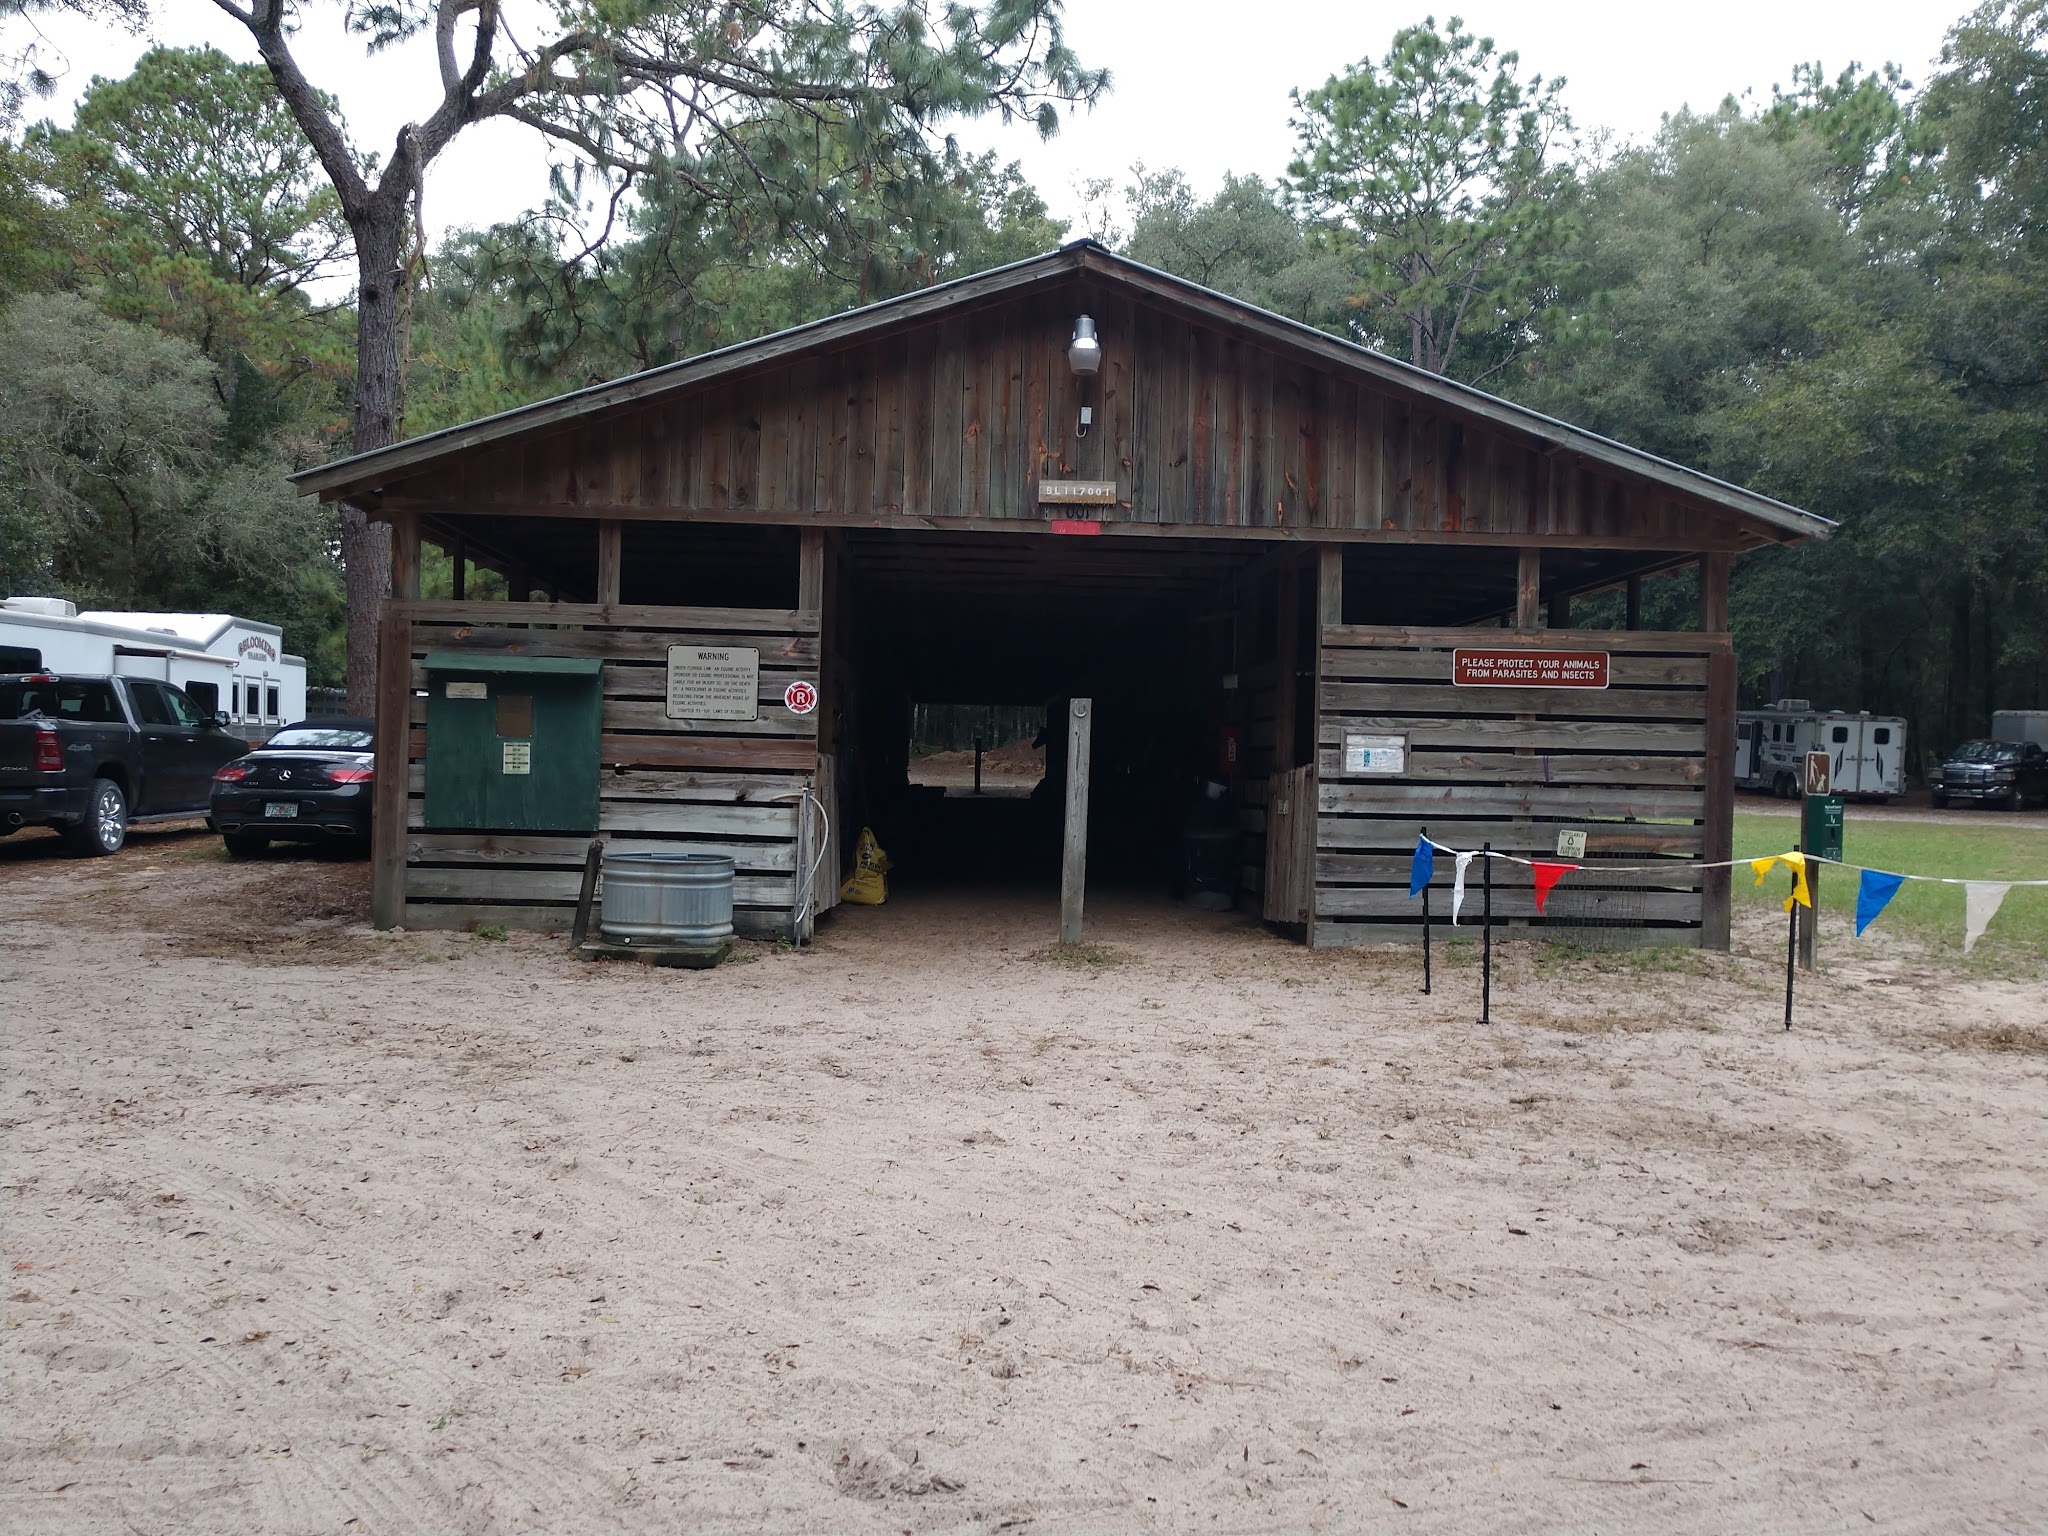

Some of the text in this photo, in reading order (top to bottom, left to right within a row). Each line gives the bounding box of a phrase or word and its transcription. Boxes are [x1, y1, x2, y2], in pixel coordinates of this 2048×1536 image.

[1046, 486, 1110, 496] BL117001
[698, 652, 729, 660] WARNING
[1462, 658, 1600, 669] PLEASE PROTECT YOUR ANIMALS
[1466, 669, 1594, 680] FROM PARASITES AND INSECTS
[796, 692, 806, 704] R
